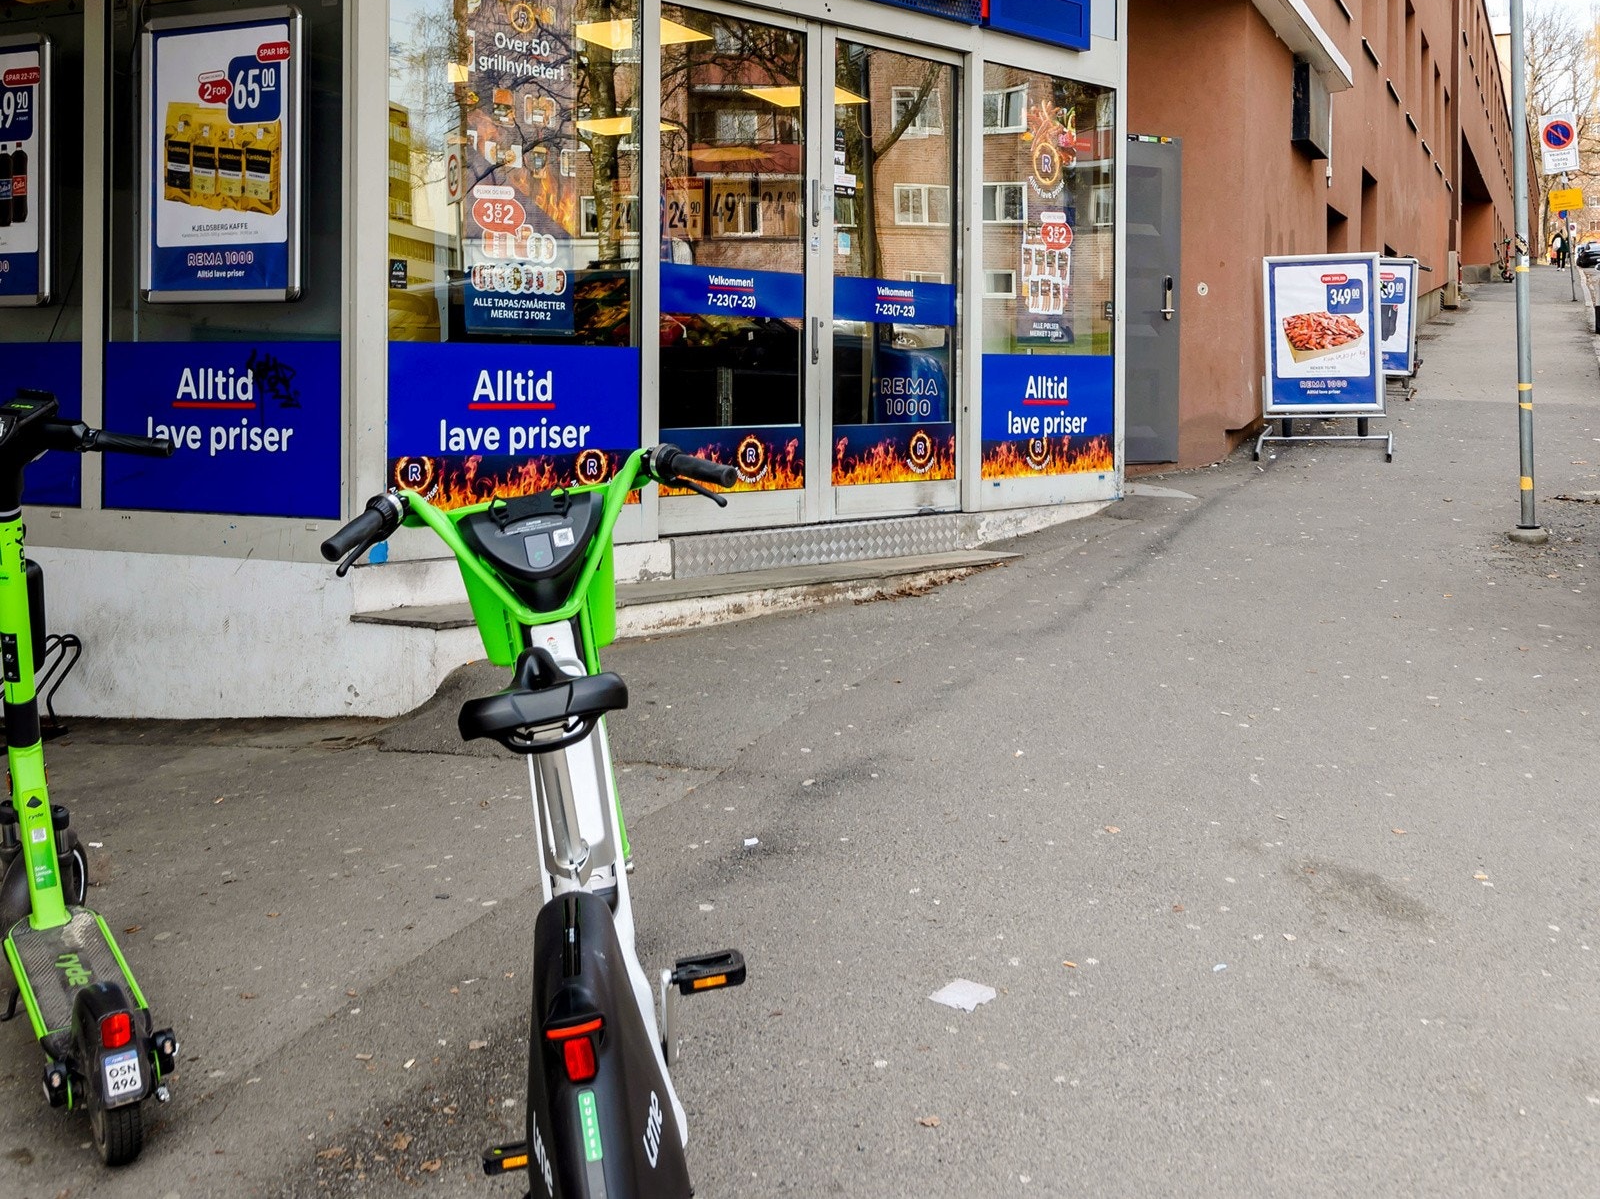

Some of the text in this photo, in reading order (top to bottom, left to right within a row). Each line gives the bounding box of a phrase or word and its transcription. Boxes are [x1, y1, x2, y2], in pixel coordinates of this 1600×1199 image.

[260, 48, 275, 56] SPAR
[494, 32, 550, 57] Over 50
[479, 53, 565, 81] grillnyheter!
[5, 73, 20, 81] SPAR
[204, 84, 226, 99] 2 FOR
[234, 68, 275, 109] 65 00
[0, 91, 28, 128] 9 90
[483, 202, 514, 225] 3 FOR 2
[668, 201, 701, 229] 24 90
[712, 192, 736, 223] 49
[192, 222, 248, 232] KJELDSBERG KAFFE
[1047, 225, 1054, 242] 3
[1060, 226, 1067, 244] 2
[188, 251, 253, 266] REMA 1000
[197, 270, 213, 278] Alltid
[227, 269, 245, 278] priser
[708, 274, 754, 289] Velkommen!
[877, 286, 914, 298] Velkommen!
[1330, 288, 1360, 305] 349 00
[473, 298, 566, 311] ALLE TAPAS/SMÅRETTER
[707, 293, 757, 310] 7-23(7-23)
[875, 303, 915, 318] 7-23(7-23)
[491, 310, 551, 320] MERKET 3 FOR 2
[176, 367, 253, 401] Alltid
[473, 369, 553, 401] Alltid
[881, 377, 938, 396] REMA
[1025, 375, 1068, 399] Alltid
[886, 398, 931, 416] 1000
[1008, 410, 1088, 438] lave priser
[210, 417, 294, 457] priser
[440, 417, 590, 456] lave priser
[746, 447, 756, 463] R
[409, 463, 421, 481] R
[587, 458, 598, 476] R
[55, 953, 91, 986] ryde
[109, 1063, 136, 1078] OSN
[113, 1077, 137, 1090] 496
